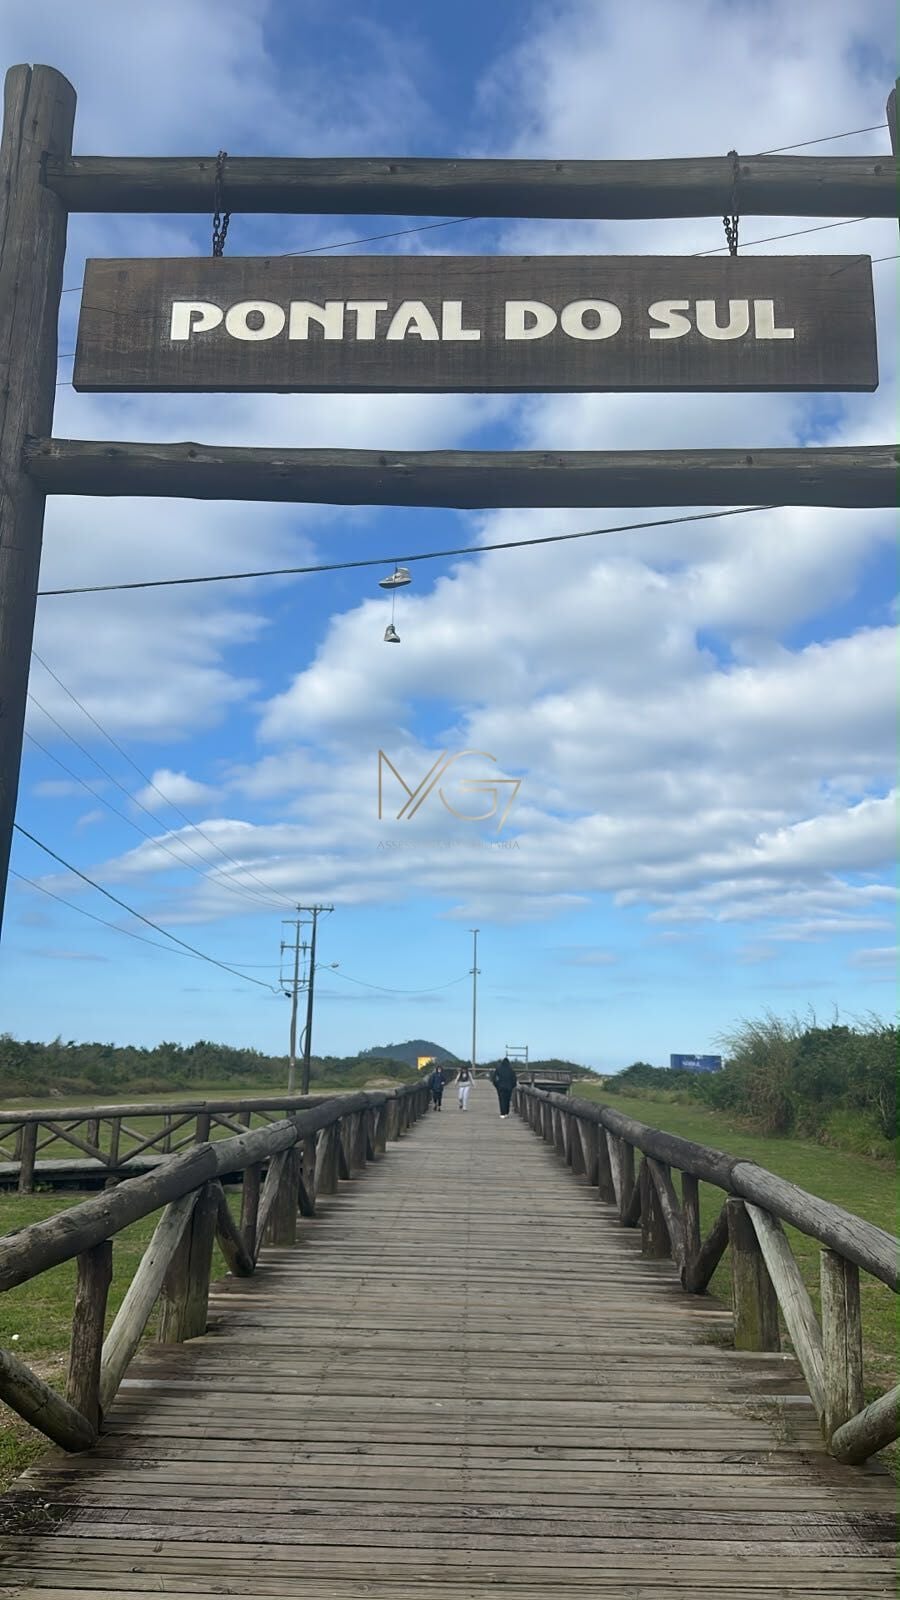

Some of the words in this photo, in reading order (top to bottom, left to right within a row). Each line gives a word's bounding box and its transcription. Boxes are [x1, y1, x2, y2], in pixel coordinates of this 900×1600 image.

[170, 300, 481, 341] PONTAL
[504, 300, 622, 341] DO
[648, 299, 795, 341] SUL
